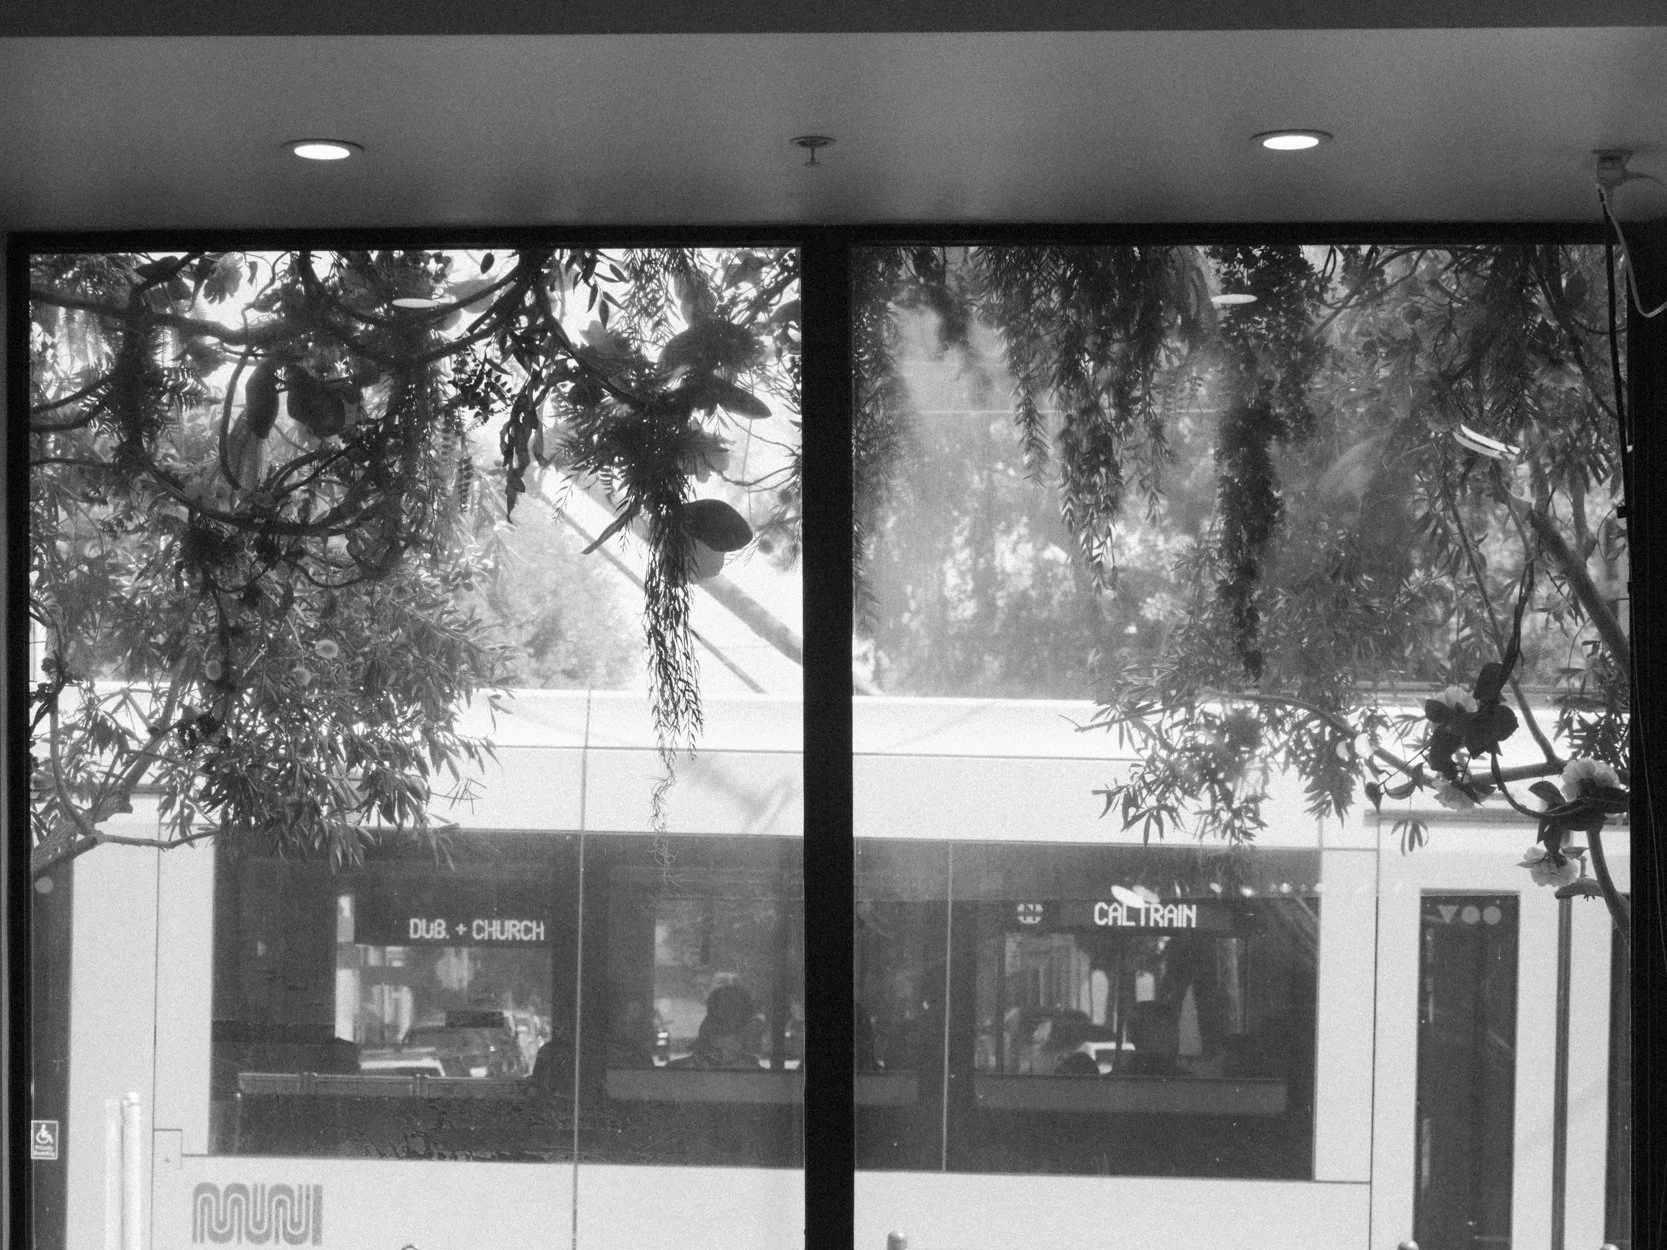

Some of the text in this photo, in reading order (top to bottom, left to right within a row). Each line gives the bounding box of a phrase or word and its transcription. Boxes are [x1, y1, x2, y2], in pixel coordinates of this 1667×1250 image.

[1094, 902, 1197, 928] CALTRAIN
[410, 918, 450, 939] DUB.
[472, 919, 545, 941] CHURCH
